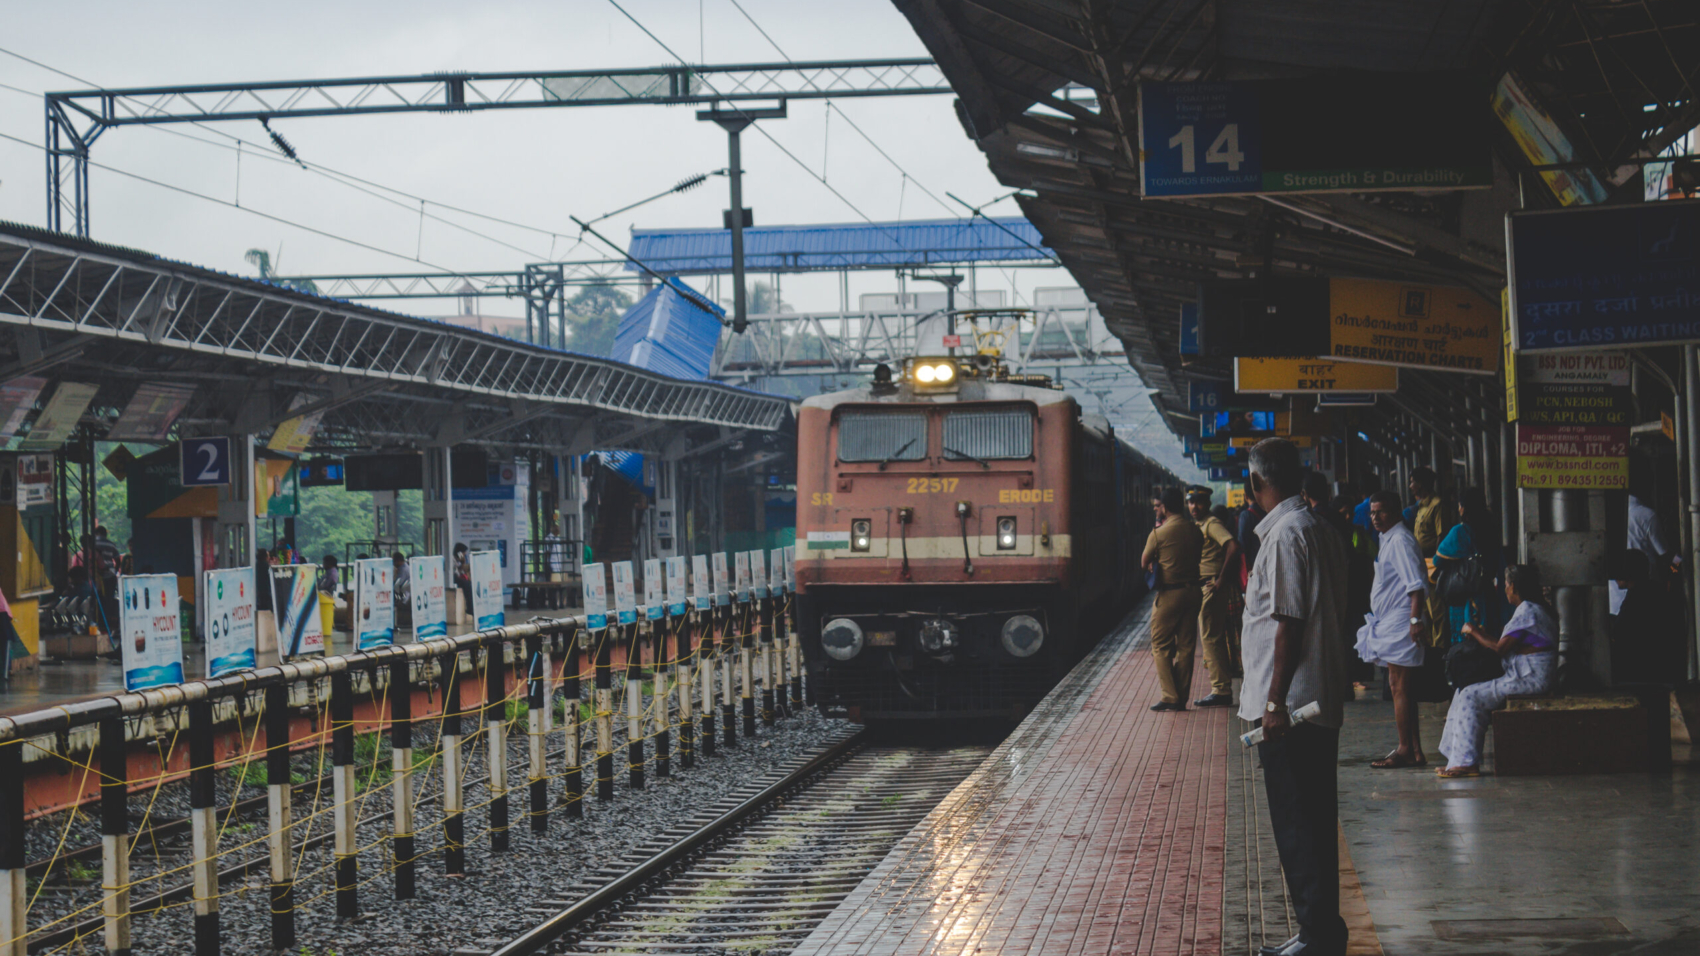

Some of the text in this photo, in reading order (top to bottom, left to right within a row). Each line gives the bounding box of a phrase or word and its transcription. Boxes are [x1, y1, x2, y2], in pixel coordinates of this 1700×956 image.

[1168, 123, 1245, 173] 14
[1150, 174, 1258, 187] TOWARDS ERNAKULAM
[1283, 170, 1464, 189] Strength & Durability
[1553, 326, 1615, 344] CLASS
[1335, 344, 1425, 364] RESERVATION
[1430, 353, 1483, 369] CHARTS
[1539, 354, 1629, 370] BSS NDT PVT. LTD.
[1554, 372, 1608, 380] ANGAMALY
[1297, 379, 1336, 389] EXIT
[1543, 385, 1584, 393] COURSES
[1196, 392, 1217, 407] 16
[1606, 411, 1626, 423] QC
[1520, 442, 1626, 457] DIPLOMA, ITI, +2
[196, 442, 220, 481] 2
[907, 477, 959, 493] 22517
[1540, 474, 1552, 484] 91
[1558, 474, 1626, 486] 8943512550
[811, 492, 833, 506] SR
[999, 489, 1054, 504] ERODE
[152, 615, 177, 633] HYCOUNT
